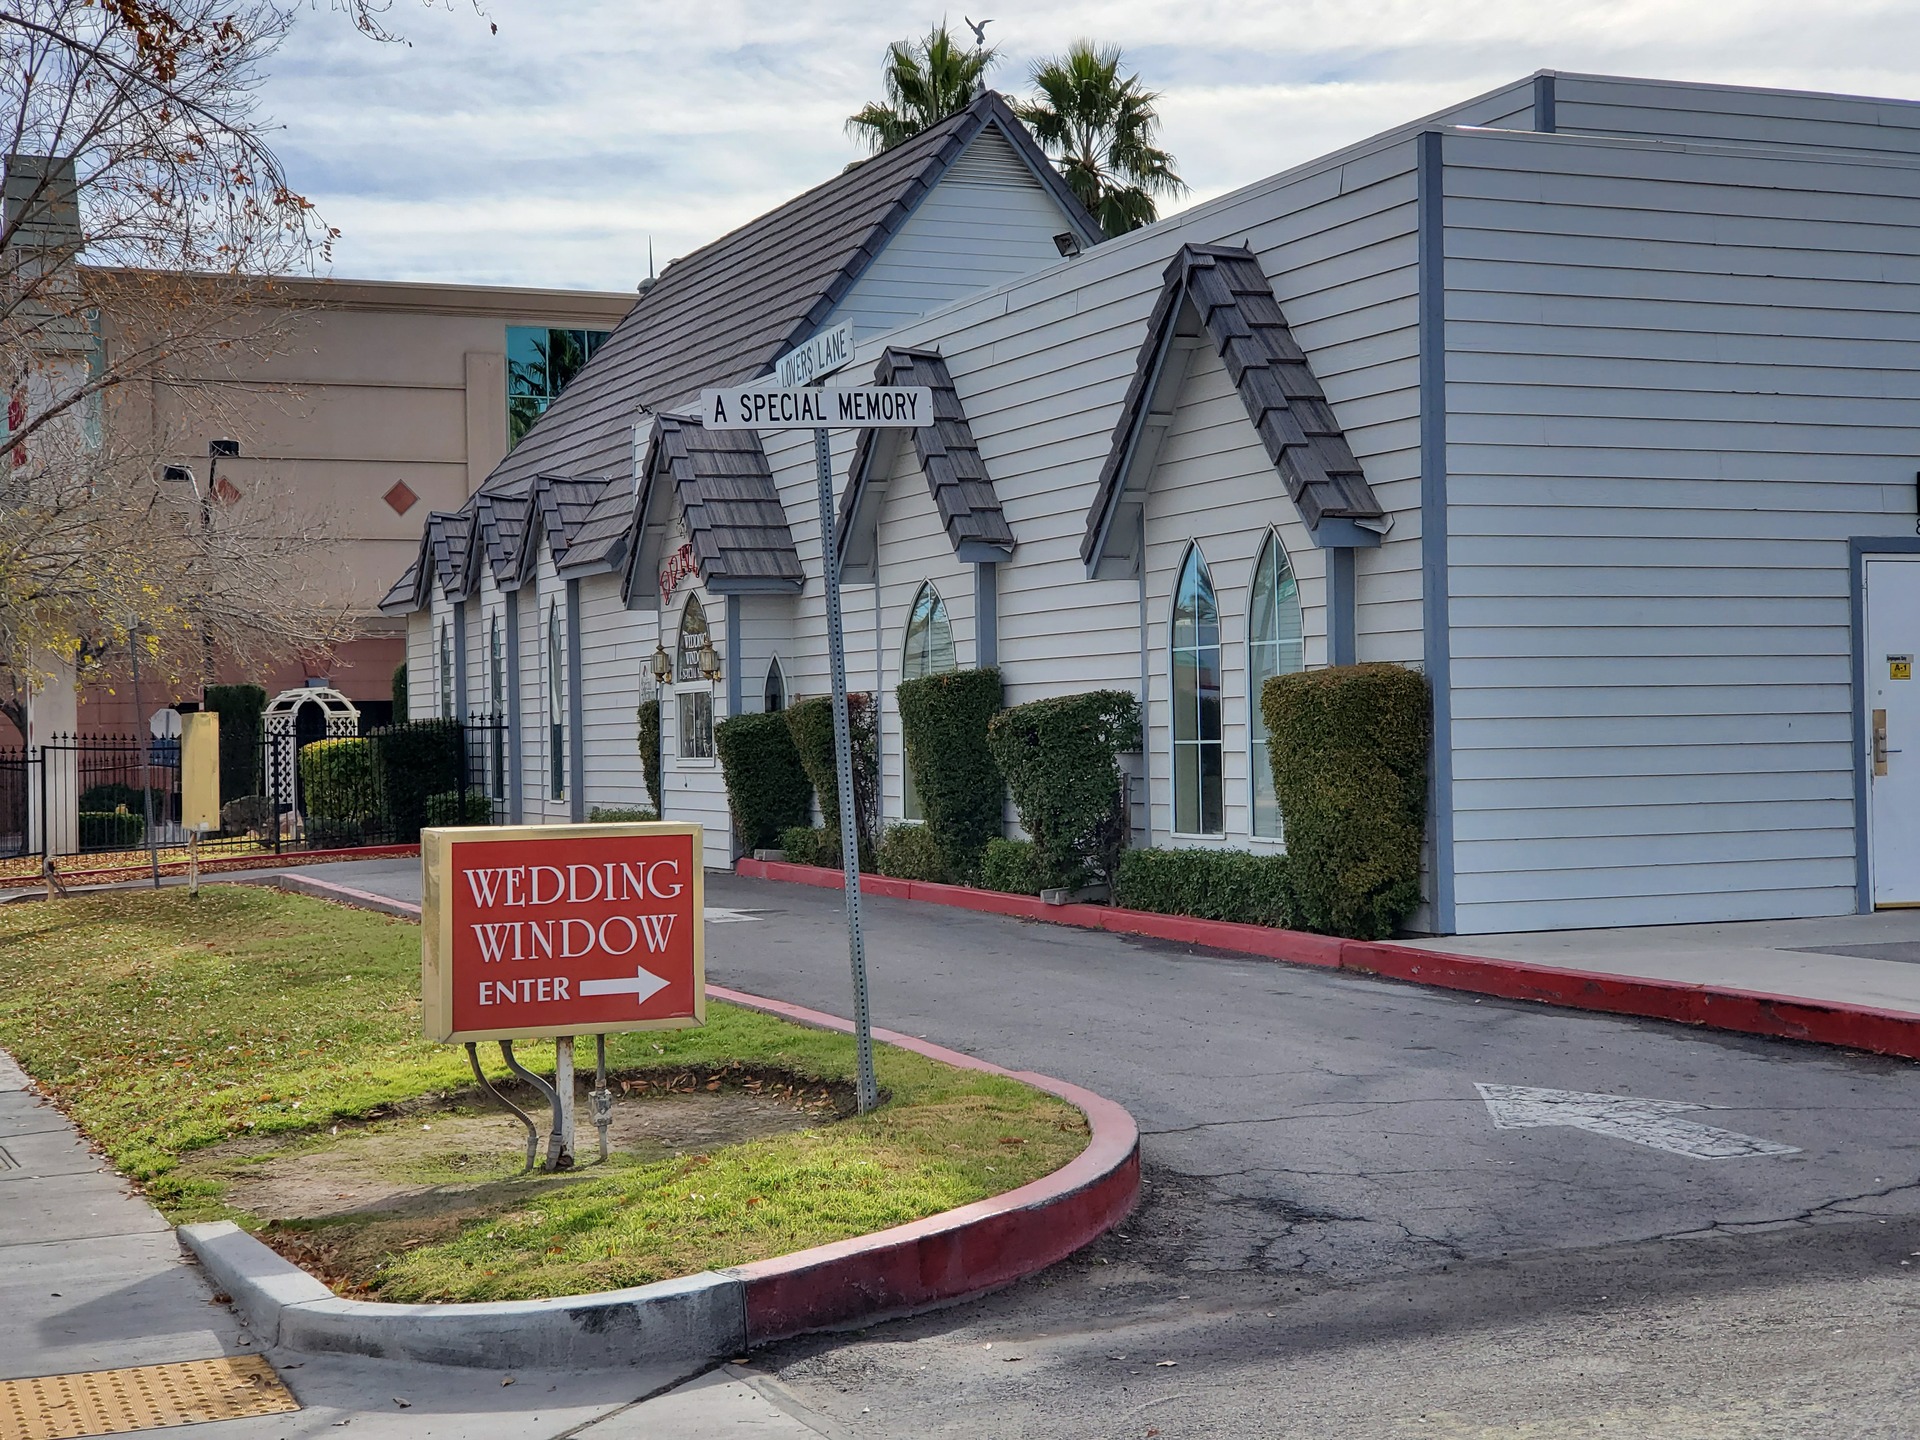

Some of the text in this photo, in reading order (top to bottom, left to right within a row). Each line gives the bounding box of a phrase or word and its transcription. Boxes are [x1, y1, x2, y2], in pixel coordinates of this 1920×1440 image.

[780, 328, 847, 388] LOVERS LANE
[714, 392, 918, 423] A SPECIAL MEMORY
[463, 859, 684, 909] WEDDING
[470, 914, 678, 963] WINDOW
[478, 976, 571, 1006] ENTER
